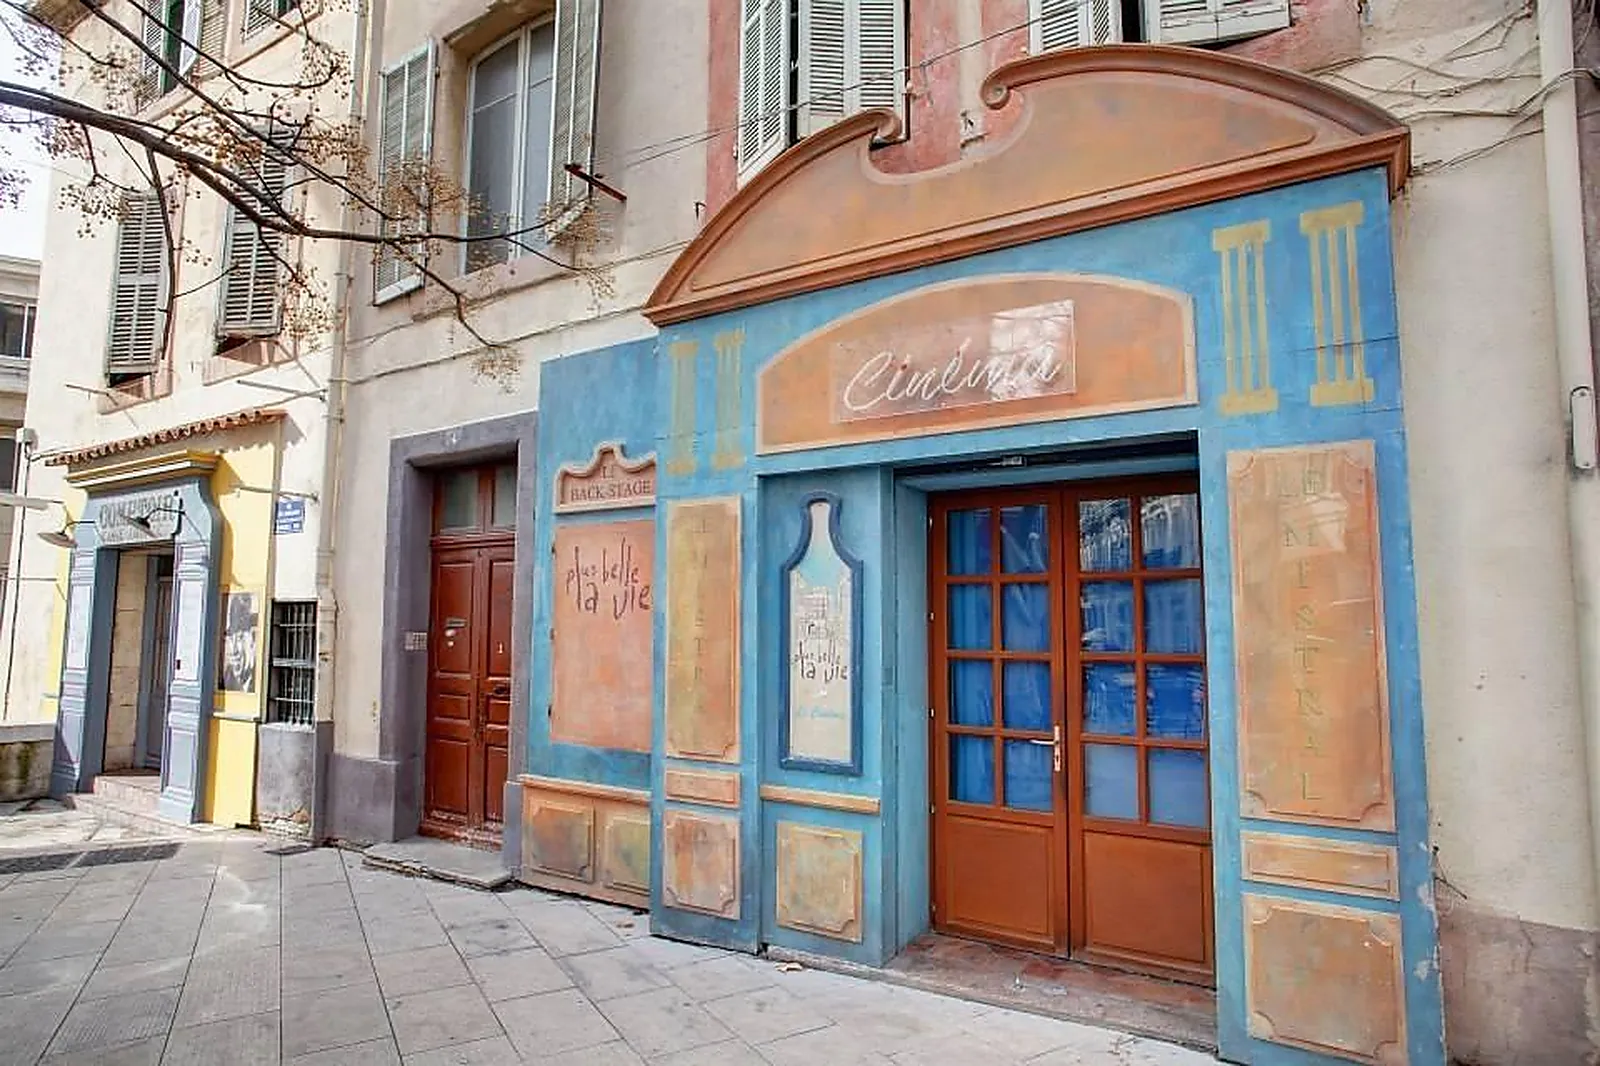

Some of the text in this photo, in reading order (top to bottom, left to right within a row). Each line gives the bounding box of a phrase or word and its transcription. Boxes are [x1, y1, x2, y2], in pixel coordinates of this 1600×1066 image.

[843, 336, 1061, 412] Cinéma
[608, 479, 651, 499] STAGE
[565, 537, 640, 596] plus belle
[612, 585, 651, 621] vie
